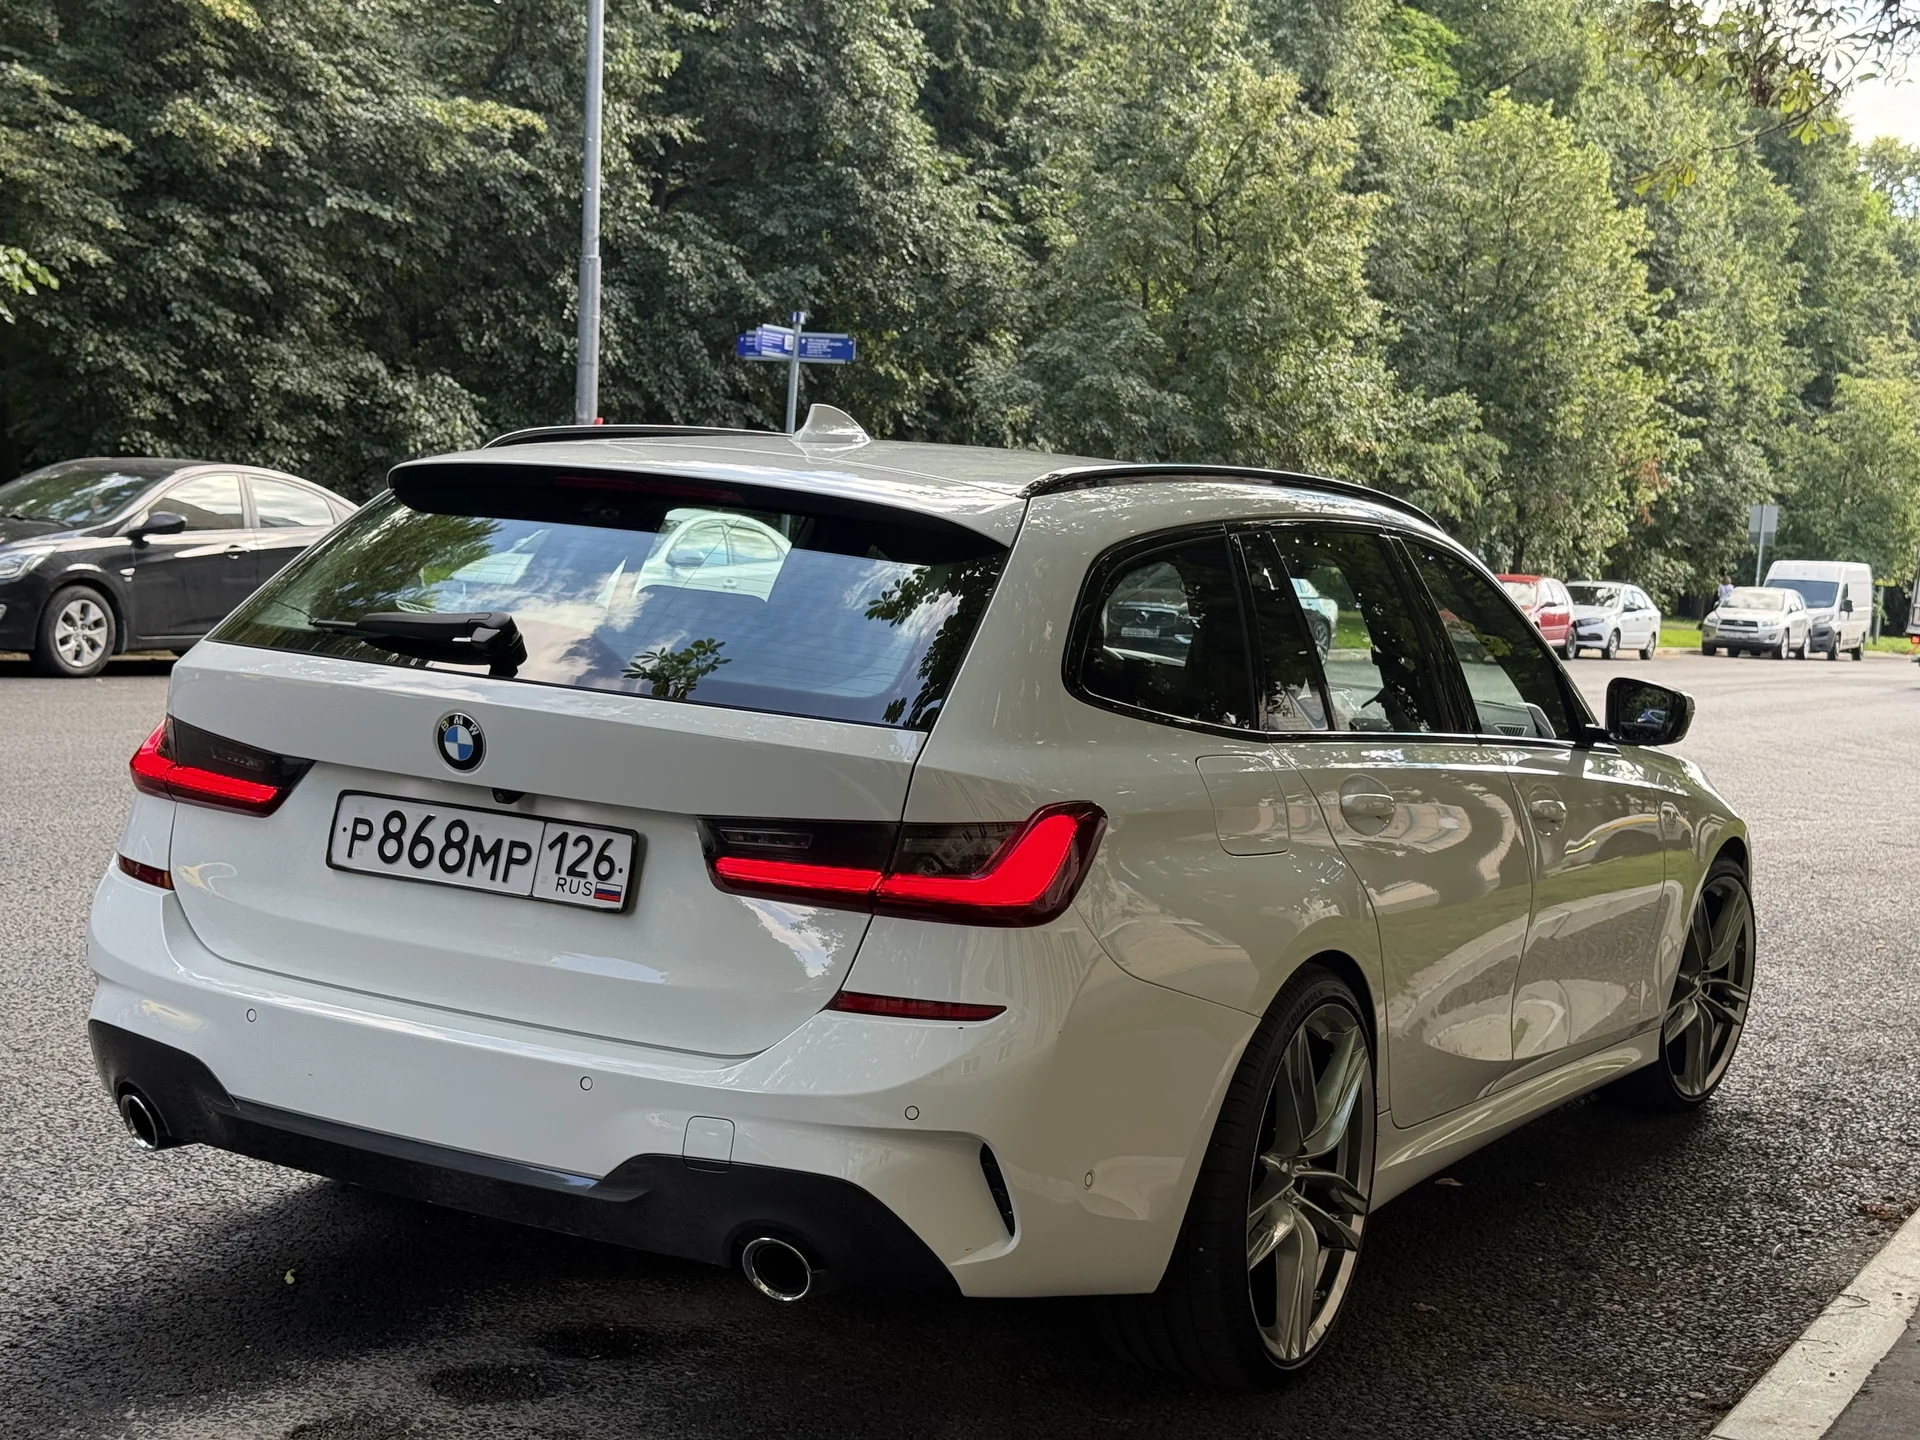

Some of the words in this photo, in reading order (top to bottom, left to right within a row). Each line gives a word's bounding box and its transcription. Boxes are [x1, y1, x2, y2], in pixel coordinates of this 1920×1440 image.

[440, 715, 480, 736] BMW
[548, 831, 616, 882] 126
[555, 876, 593, 897] RUS
[1285, 987, 1325, 1031] TRIANGLE
